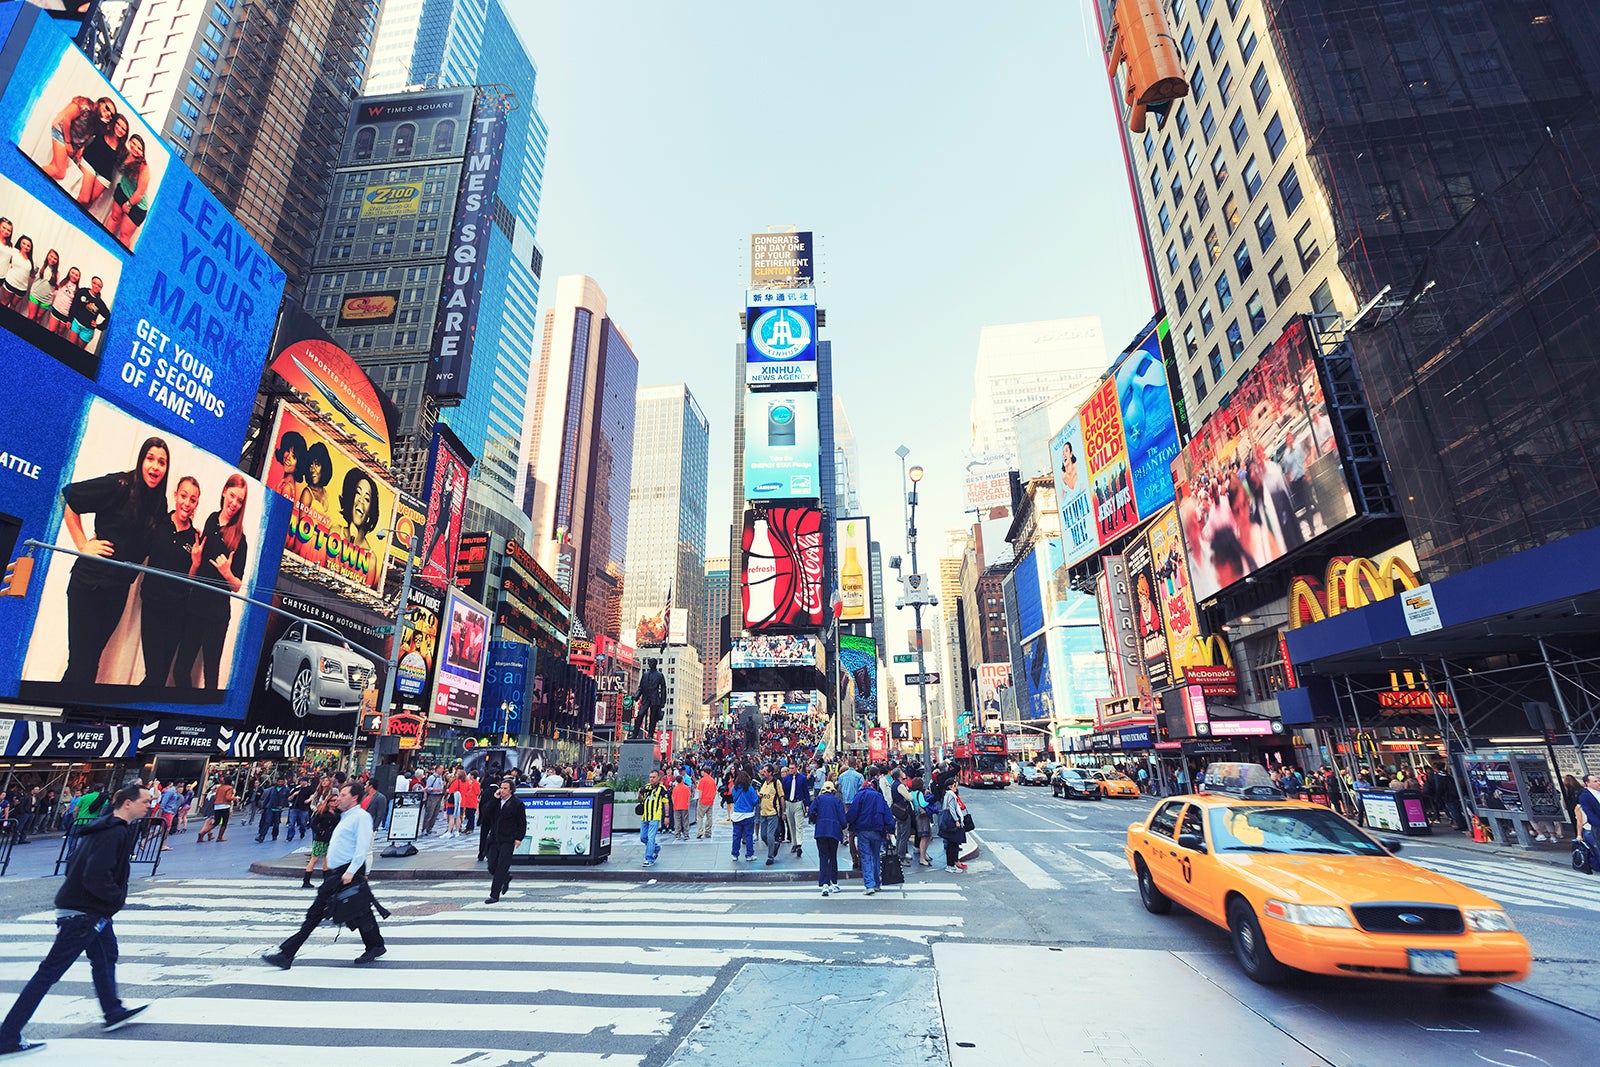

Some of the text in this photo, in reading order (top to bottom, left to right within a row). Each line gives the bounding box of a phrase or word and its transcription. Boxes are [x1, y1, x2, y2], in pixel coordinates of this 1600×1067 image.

[368, 101, 454, 117] W TIMES SQUARE
[371, 187, 415, 205] Z100
[178, 180, 267, 291] LEAVE
[440, 117, 496, 357] TIMES SQUARE
[754, 236, 800, 245] CONGRATS
[754, 243, 805, 252] ON DAY ONE
[754, 251, 791, 260] OF YOUR
[754, 258, 809, 268] RETIREMENT
[179, 232, 256, 331] YOUR
[754, 267, 802, 276] CLINTON P.
[752, 293, 810, 302] 新华通讯社
[149, 270, 245, 364] MARK
[136, 318, 214, 388] GET YOUR
[130, 340, 226, 419] 15 SECONDS
[305, 348, 339, 383] IMPORTED
[339, 381, 357, 400] FROM
[751, 374, 776, 382] NEWS
[761, 365, 802, 375] XINHUA
[121, 362, 196, 425] OF FAME.
[1081, 381, 1115, 427] THE
[1085, 402, 1117, 441] CROWD
[1087, 417, 1120, 458] GOES
[1089, 433, 1123, 475] WILD!
[1134, 442, 1178, 482] PHANTOM
[965, 475, 984, 484] BEST
[967, 481, 988, 490] THE
[967, 488, 1003, 498] MUSICAL
[968, 496, 985, 504] THIS
[295, 501, 331, 526] BROADWAY
[397, 502, 427, 526] venue
[1062, 493, 1090, 529] MAMMA
[1098, 495, 1117, 522] JERSEY
[396, 516, 415, 549] Q
[462, 536, 487, 544] REUTERS
[326, 560, 367, 585] THE MUSICAL
[554, 551, 572, 596] SHEY'S
[748, 565, 775, 573] refresh
[412, 591, 425, 605] JOY
[1168, 593, 1187, 618] NICE
[282, 596, 320, 617] CHRYSLER
[321, 610, 334, 623] 300
[336, 615, 362, 632] MOTOWN
[1169, 608, 1192, 633] WORK
[590, 674, 623, 692] HEY'S
[1188, 670, 1235, 678] McDonald's
[73, 741, 98, 750] OPEN
[76, 732, 104, 741] WE'RE
[161, 736, 212, 747] ENTER HERE
